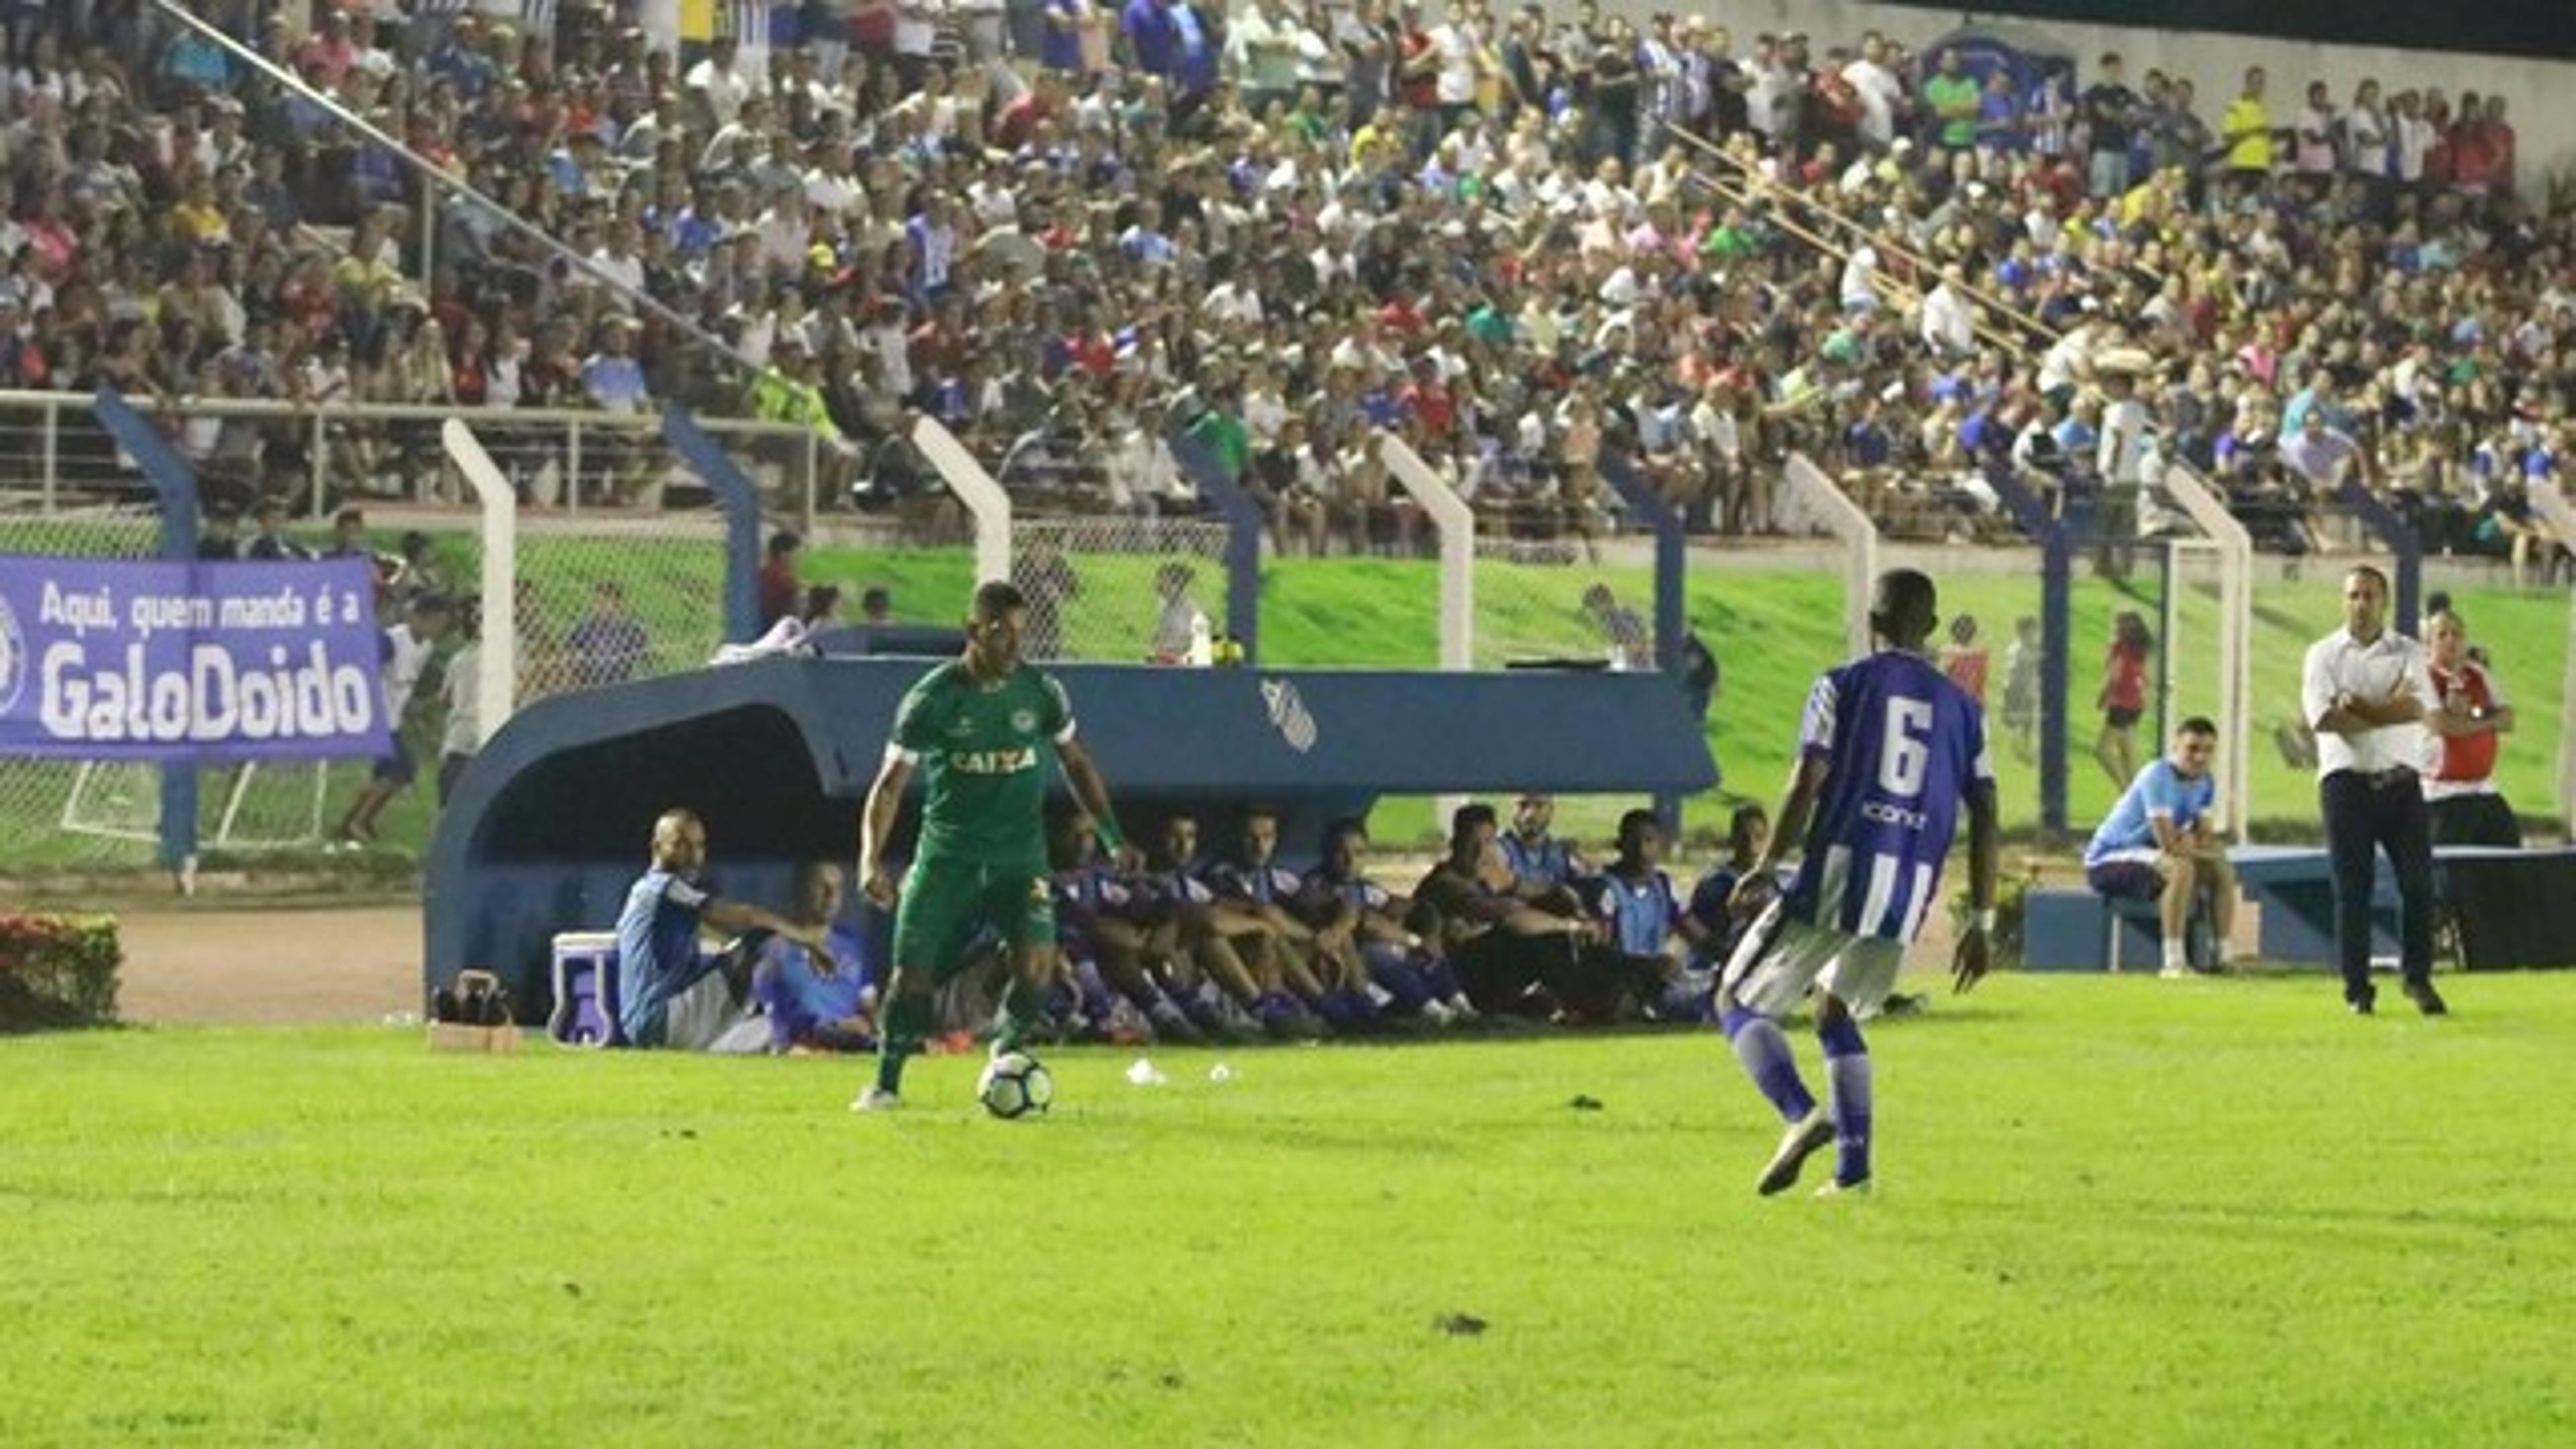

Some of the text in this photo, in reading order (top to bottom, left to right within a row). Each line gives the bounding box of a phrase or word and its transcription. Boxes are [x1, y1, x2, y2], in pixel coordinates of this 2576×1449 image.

[40, 581, 359, 639] Aqui, quem manda é a
[40, 639, 372, 741] GaloDoido
[950, 746, 1037, 773] CAIXA
[1880, 695, 1933, 797] 6
